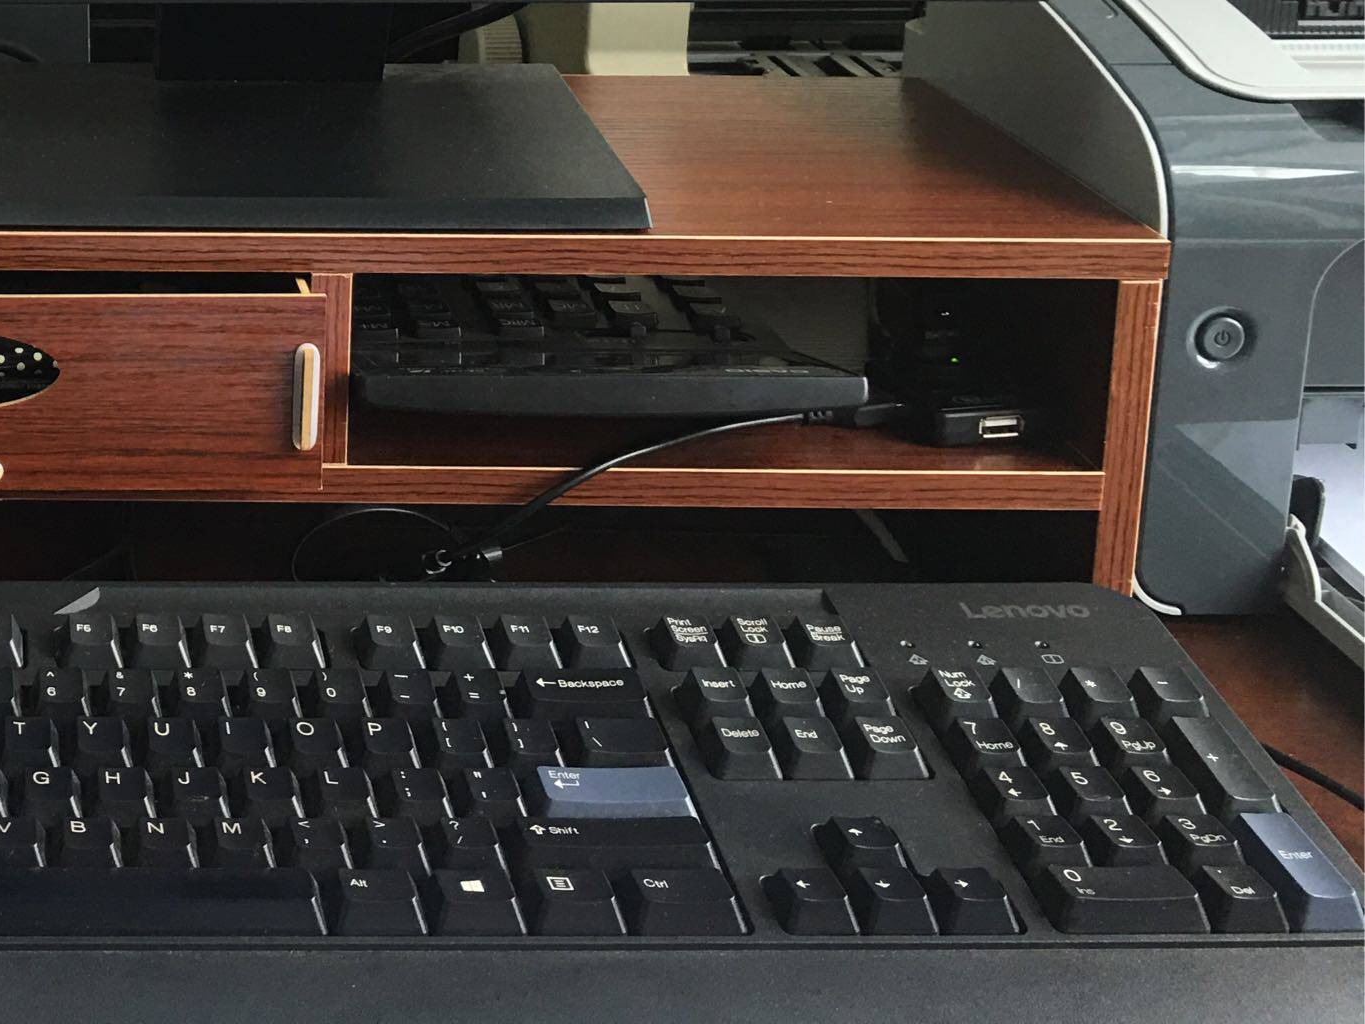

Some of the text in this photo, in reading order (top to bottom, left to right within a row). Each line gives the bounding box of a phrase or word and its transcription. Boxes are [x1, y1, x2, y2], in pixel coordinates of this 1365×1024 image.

[959, 602, 1092, 623] Lenovo
[665, 617, 692, 626] Print
[735, 617, 769, 626] Scroll
[76, 623, 92, 633] F5
[142, 623, 158, 633] F6
[209, 624, 226, 634] F7
[276, 624, 292, 633] F8
[376, 625, 393, 634] F9
[442, 624, 465, 634] F10
[510, 624, 530, 633] F11
[577, 624, 600, 634] F12
[670, 624, 708, 634] Screen
[739, 625, 769, 634] Lock
[805, 624, 842, 633] Pause
[809, 632, 845, 643] Break
[838, 674, 872, 686] Page
[938, 669, 969, 680] Num
[557, 679, 624, 689] Backspace
[701, 678, 736, 688] Insert
[770, 679, 807, 690] Home
[944, 678, 976, 689] Lock
[46, 686, 57, 697] 6
[116, 686, 126, 697] 7
[186, 686, 197, 697] 8
[256, 687, 267, 697] 9
[326, 687, 337, 698] 0
[845, 684, 866, 696] Up
[12, 721, 26, 735] T
[82, 720, 98, 735] Y
[154, 722, 170, 736] U
[225, 721, 231, 735] I
[296, 721, 315, 736] O
[367, 722, 382, 736] P
[720, 727, 760, 738] Delete
[863, 723, 895, 734] Page
[963, 721, 977, 735] 7
[1038, 722, 1056, 736] 8
[1109, 721, 1127, 735] 9
[794, 729, 819, 739] End
[869, 732, 907, 745] Down
[975, 740, 1014, 750] Home
[1121, 739, 1156, 754] PgUp
[32, 771, 50, 785] G
[105, 771, 121, 785] H
[177, 771, 190, 785] J
[250, 771, 267, 785] K
[323, 770, 339, 785] L
[546, 770, 581, 780] Enter
[998, 771, 1013, 784] 4
[1071, 771, 1089, 785] 5
[1142, 769, 1161, 782] 6
[70, 820, 87, 833] B
[146, 821, 165, 834] N
[221, 821, 242, 835] M
[1026, 819, 1041, 831] 1
[1103, 818, 1123, 831] 2
[1178, 818, 1196, 830] 3
[548, 826, 579, 835] Shift
[1038, 835, 1065, 847] End
[1189, 833, 1227, 846] PgDn
[1063, 869, 1082, 882] 0
[350, 878, 368, 888] Alt
[643, 878, 669, 889] Ctrl
[1075, 886, 1096, 895] Ins
[1230, 885, 1256, 895] Del
